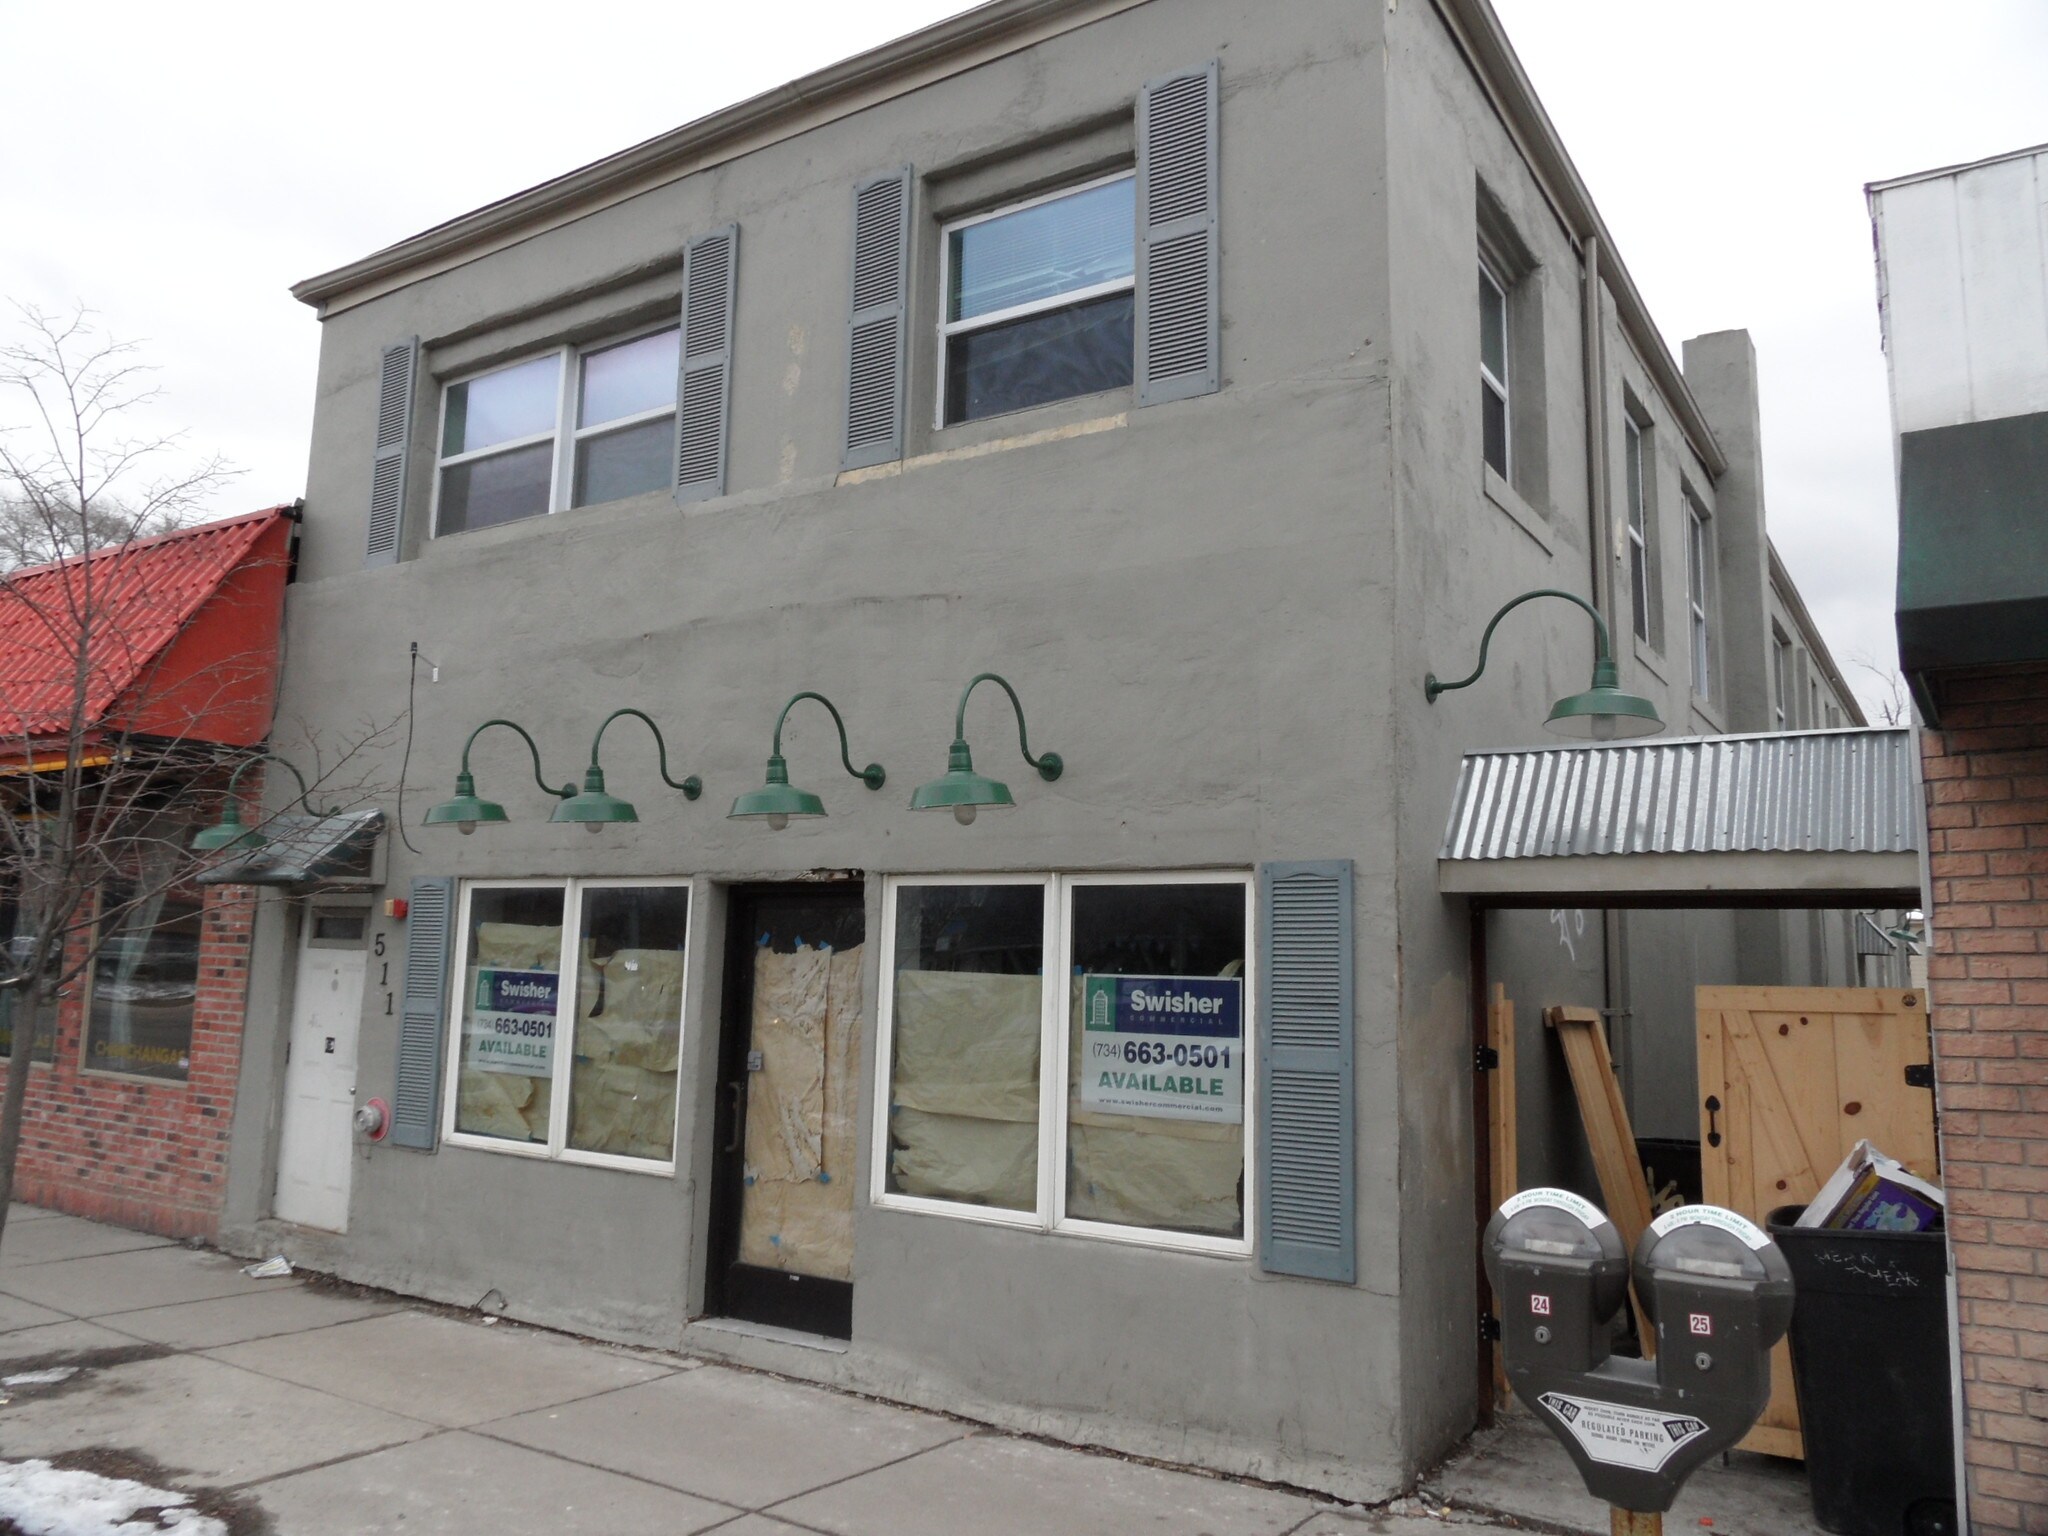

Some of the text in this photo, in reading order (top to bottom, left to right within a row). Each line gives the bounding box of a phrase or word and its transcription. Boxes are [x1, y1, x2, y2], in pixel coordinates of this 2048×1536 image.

[501, 980, 552, 999] Swisher
[1130, 989, 1223, 1014] Swisher
[495, 1018, 553, 1038] 663-0501
[478, 1040, 547, 1058] AVAILABLE
[1092, 1040, 1231, 1069] (734) 663-0501
[1098, 1071, 1224, 1096] AVAILABLE
[1098, 1098, 1224, 1112] www.swishercommercial.com
[1565, 1196, 1586, 1209] LIMIT
[1702, 1208, 1722, 1217] TIME
[1725, 1214, 1748, 1229] LIMIT
[1533, 1297, 1548, 1312] 24
[1692, 1316, 1709, 1333] 25
[1547, 1396, 1578, 1421] THIS CAR
[1581, 1420, 1626, 1436] REGULATED
[1629, 1428, 1665, 1443] PARKING
[1667, 1423, 1683, 1438] THIS
